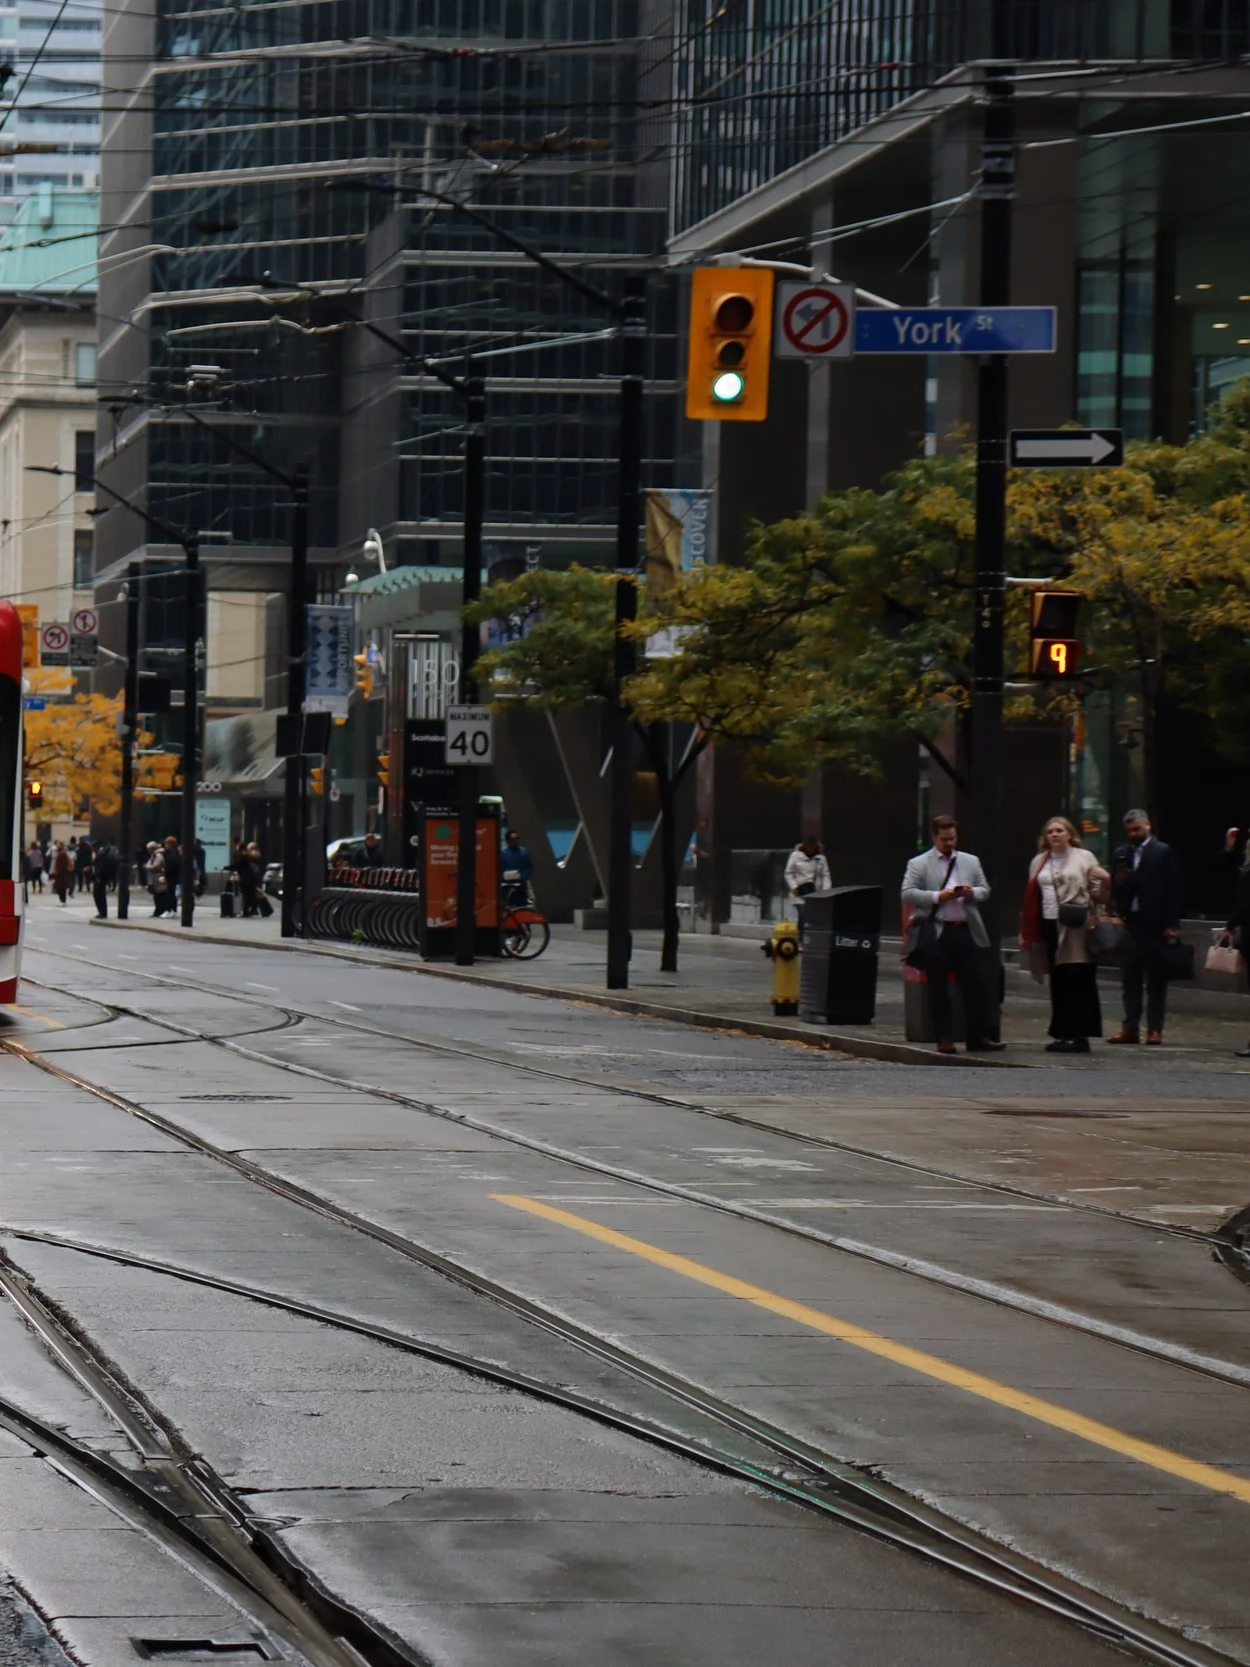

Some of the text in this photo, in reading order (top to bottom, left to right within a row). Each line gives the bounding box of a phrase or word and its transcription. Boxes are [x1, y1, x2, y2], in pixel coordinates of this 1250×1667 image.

[893, 316, 962, 344] York
[976, 315, 994, 330] St
[690, 497, 709, 583] ISCOVER
[1050, 643, 1067, 674] 9
[412, 659, 460, 685] 150
[450, 712, 490, 721] MAXIMUM
[411, 733, 446, 742] Scotiaba
[450, 730, 489, 757] 40
[835, 935, 858, 948] Litter
